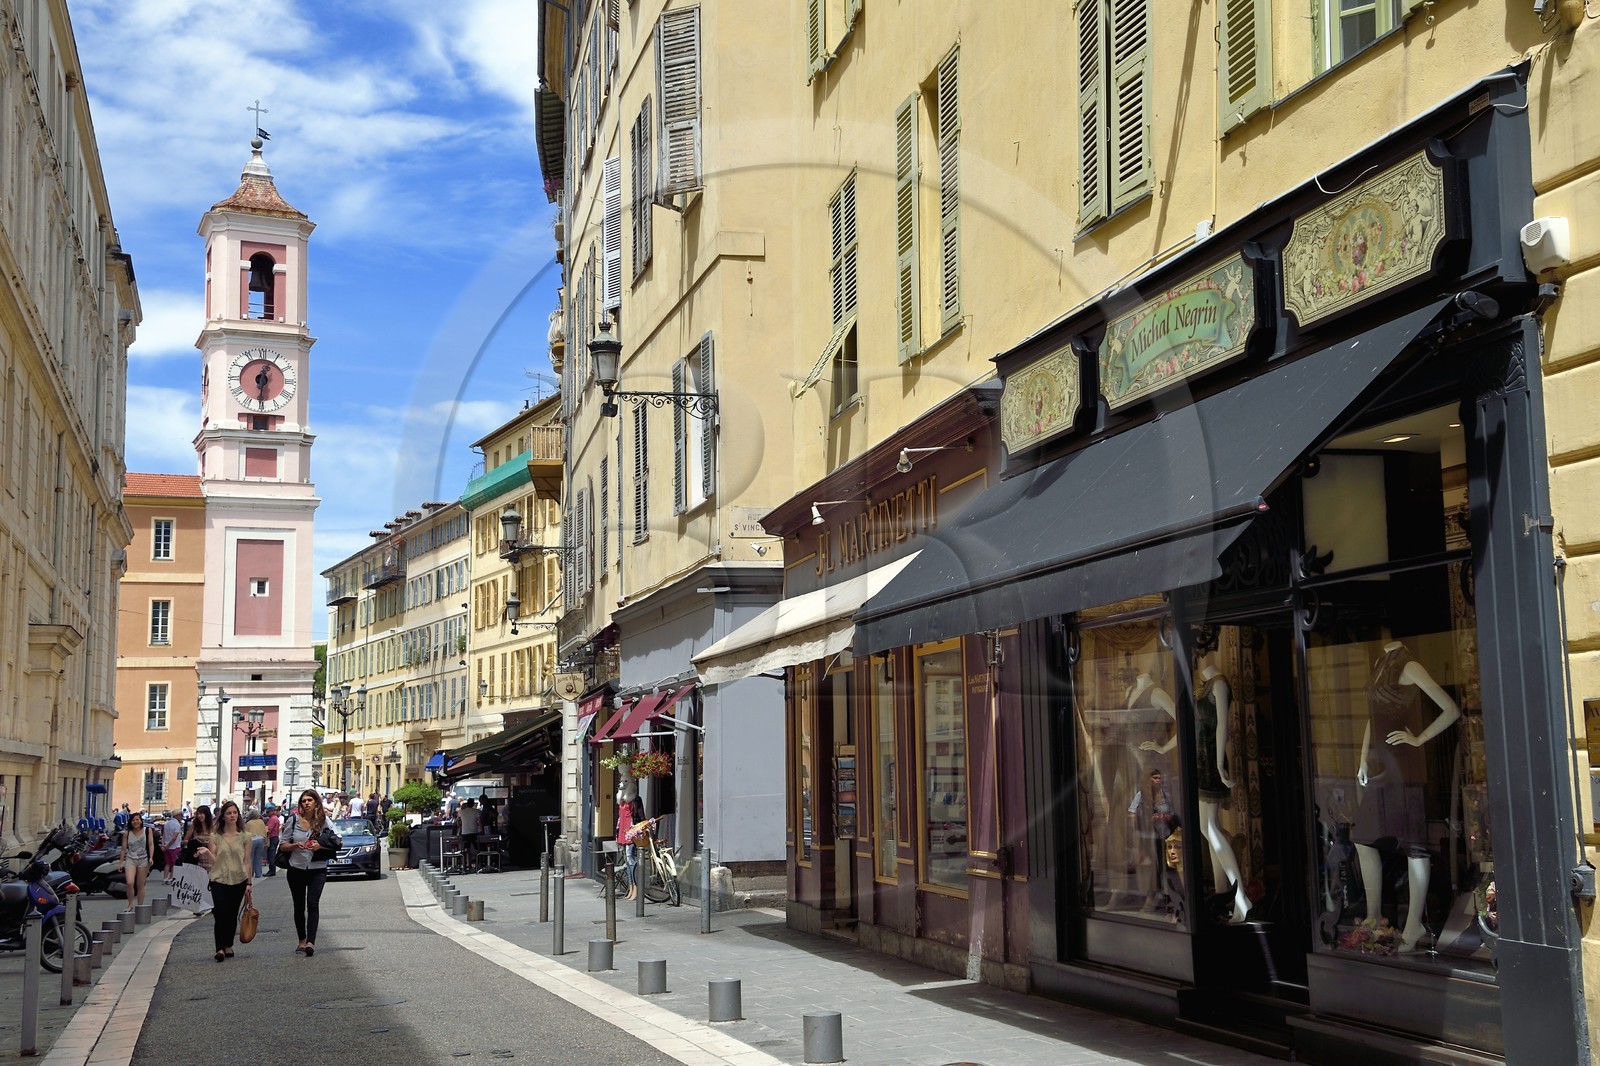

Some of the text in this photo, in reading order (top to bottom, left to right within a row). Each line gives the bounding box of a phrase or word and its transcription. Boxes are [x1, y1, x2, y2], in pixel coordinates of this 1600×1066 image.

[1130, 299, 1217, 363] Michal Negrin
[839, 476, 937, 566] MARTINETTI
